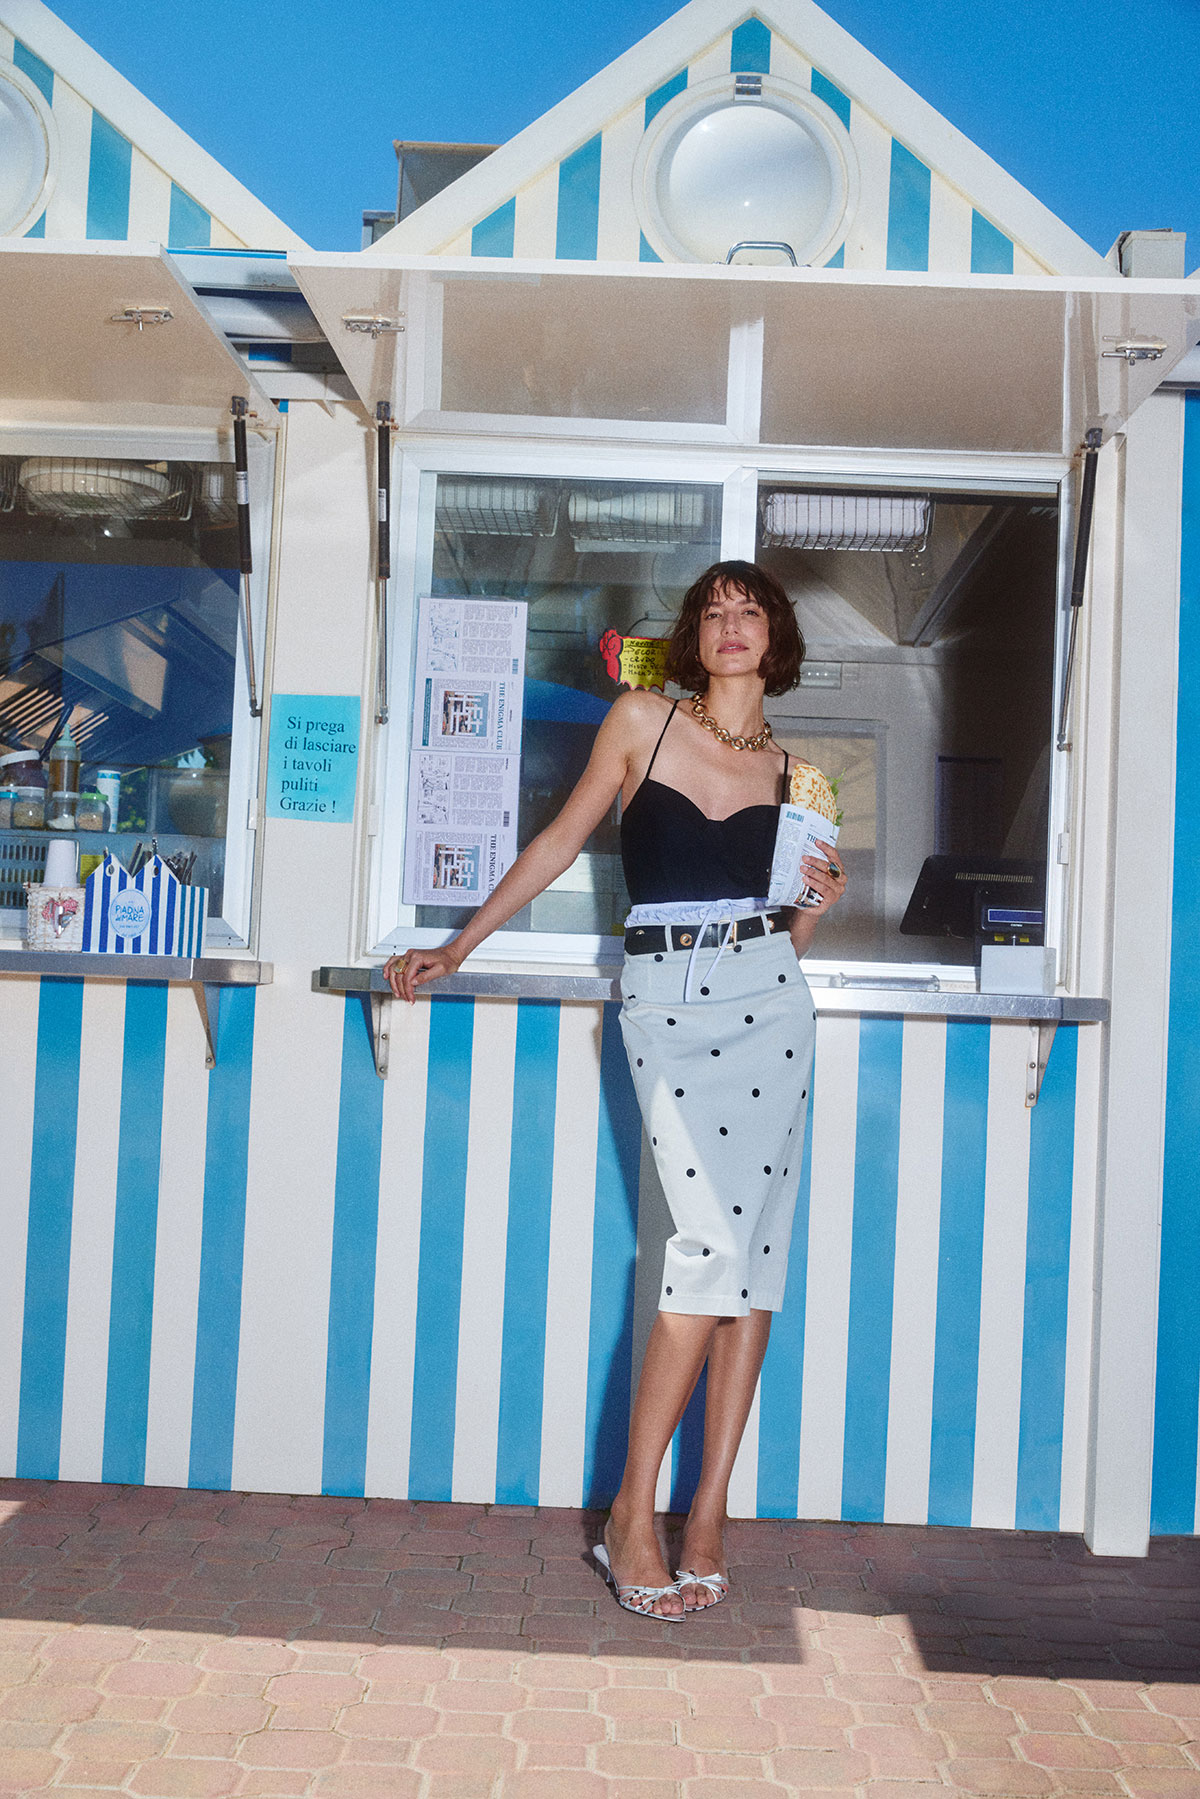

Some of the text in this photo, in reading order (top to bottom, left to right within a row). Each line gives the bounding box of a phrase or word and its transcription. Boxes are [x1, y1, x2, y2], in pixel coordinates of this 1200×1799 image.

[497, 700, 505, 729] ENIGMA
[287, 716, 345, 735] Si prega
[284, 736, 357, 754] di lasciare
[496, 730, 504, 750] CLUB
[283, 756, 332, 772] i tavoli
[281, 777, 318, 793] puliti
[279, 797, 327, 813] Grazie
[488, 851, 496, 882] ENIGMA
